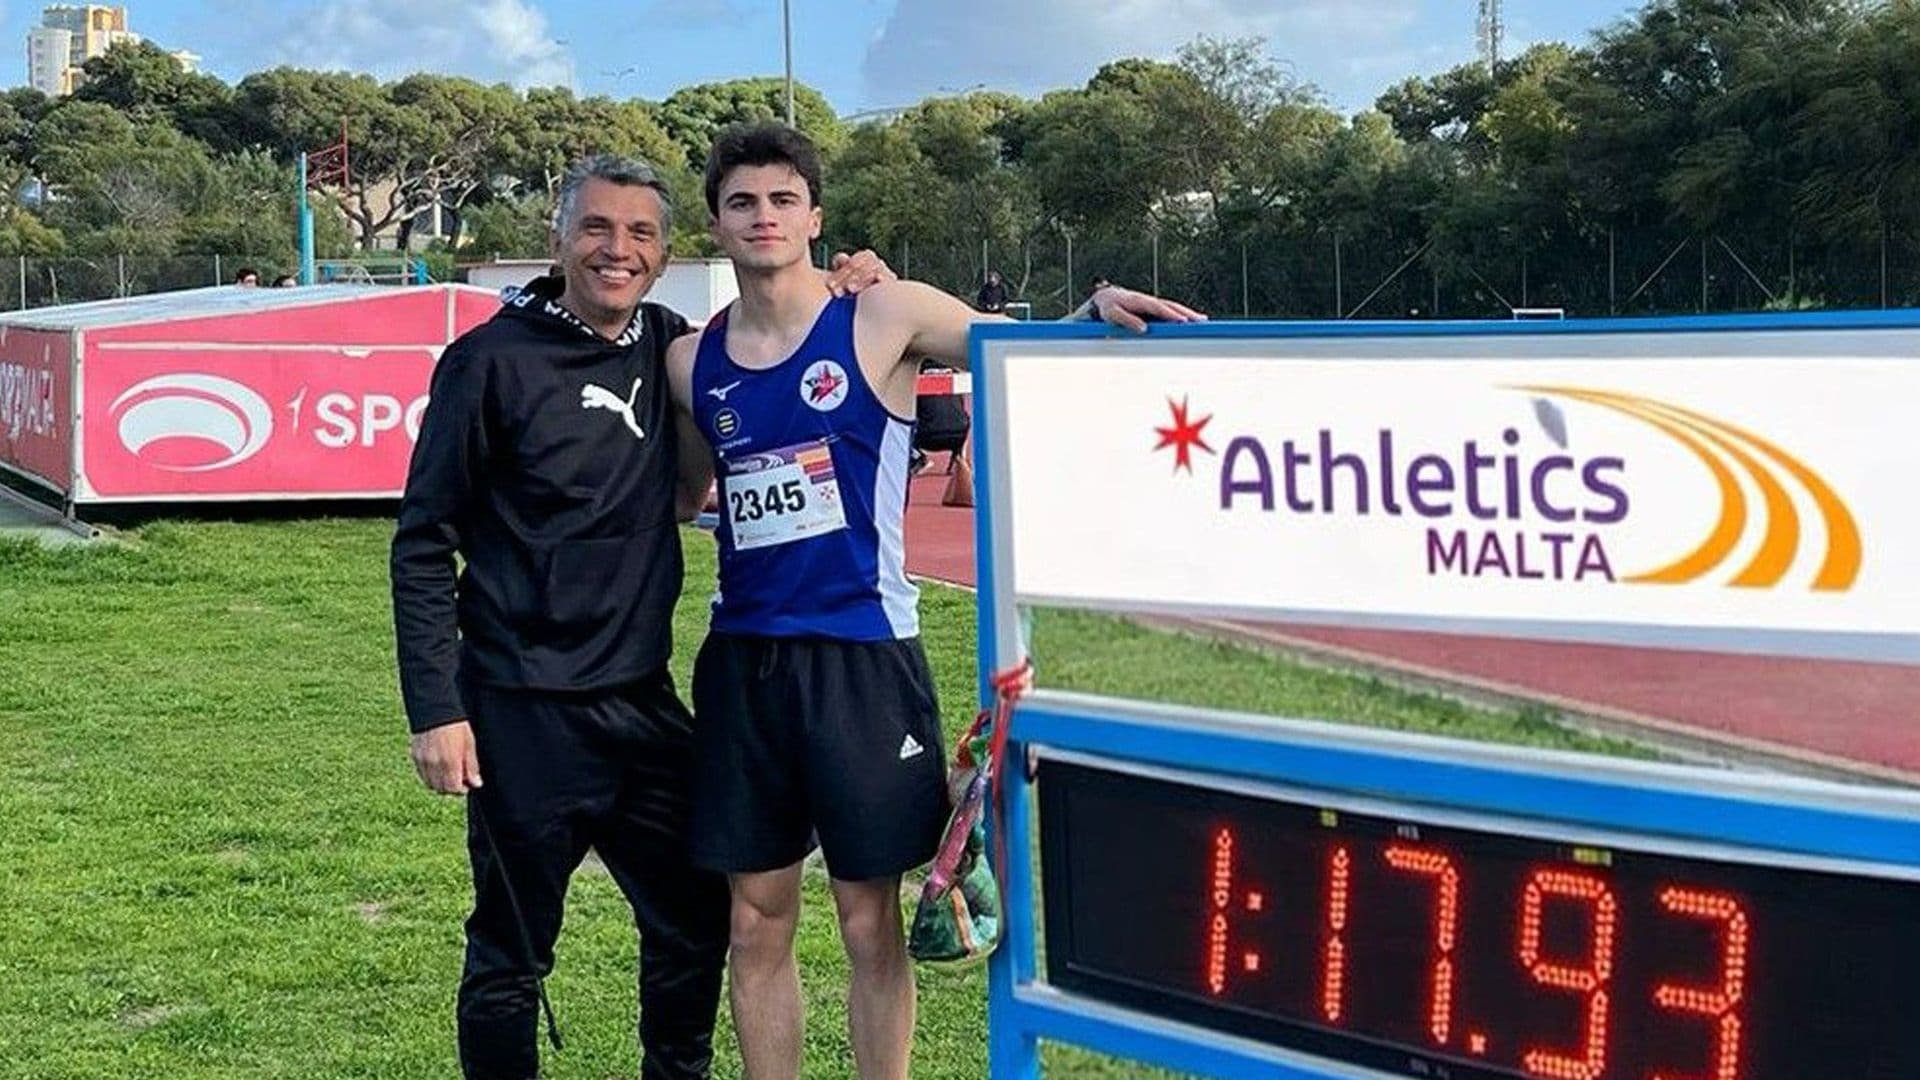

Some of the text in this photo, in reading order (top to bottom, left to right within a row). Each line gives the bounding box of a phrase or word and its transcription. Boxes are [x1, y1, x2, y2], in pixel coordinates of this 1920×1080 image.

[730, 480, 806, 523] 2345
[1219, 428, 1630, 523] Athletics
[1426, 528, 1617, 583] MALTA
[1207, 827, 1749, 1080] 1:17.93
